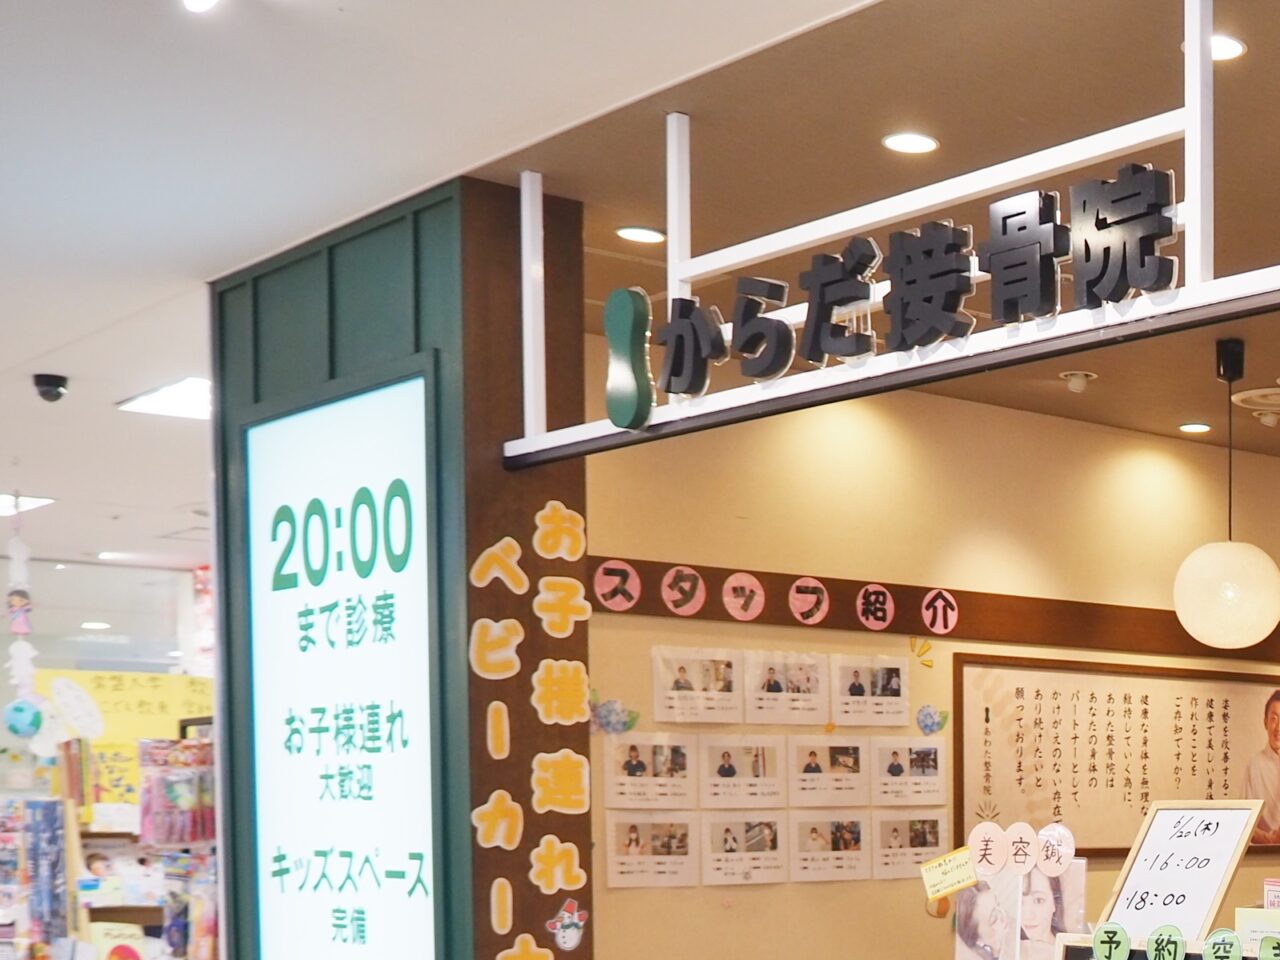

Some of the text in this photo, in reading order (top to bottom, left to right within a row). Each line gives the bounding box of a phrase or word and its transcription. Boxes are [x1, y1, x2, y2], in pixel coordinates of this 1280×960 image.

[658, 163, 1178, 397] からだ接骨院
[271, 478, 413, 591] 20:00
[297, 590, 396, 652] まで診療
[601, 567, 956, 630] スタッフ紹介
[284, 699, 409, 756] お子様連れ
[531, 500, 592, 894] お子様連れ
[1033, 688, 1044, 788] あり続けたいと
[1088, 691, 1098, 788] あなたの身体の
[1190, 696, 1199, 776] 作れることを
[319, 763, 374, 800] 大歓迎
[271, 845, 430, 897] キッズスペース
[977, 832, 1063, 866] 美容鍼
[332, 905, 367, 945] 完備
